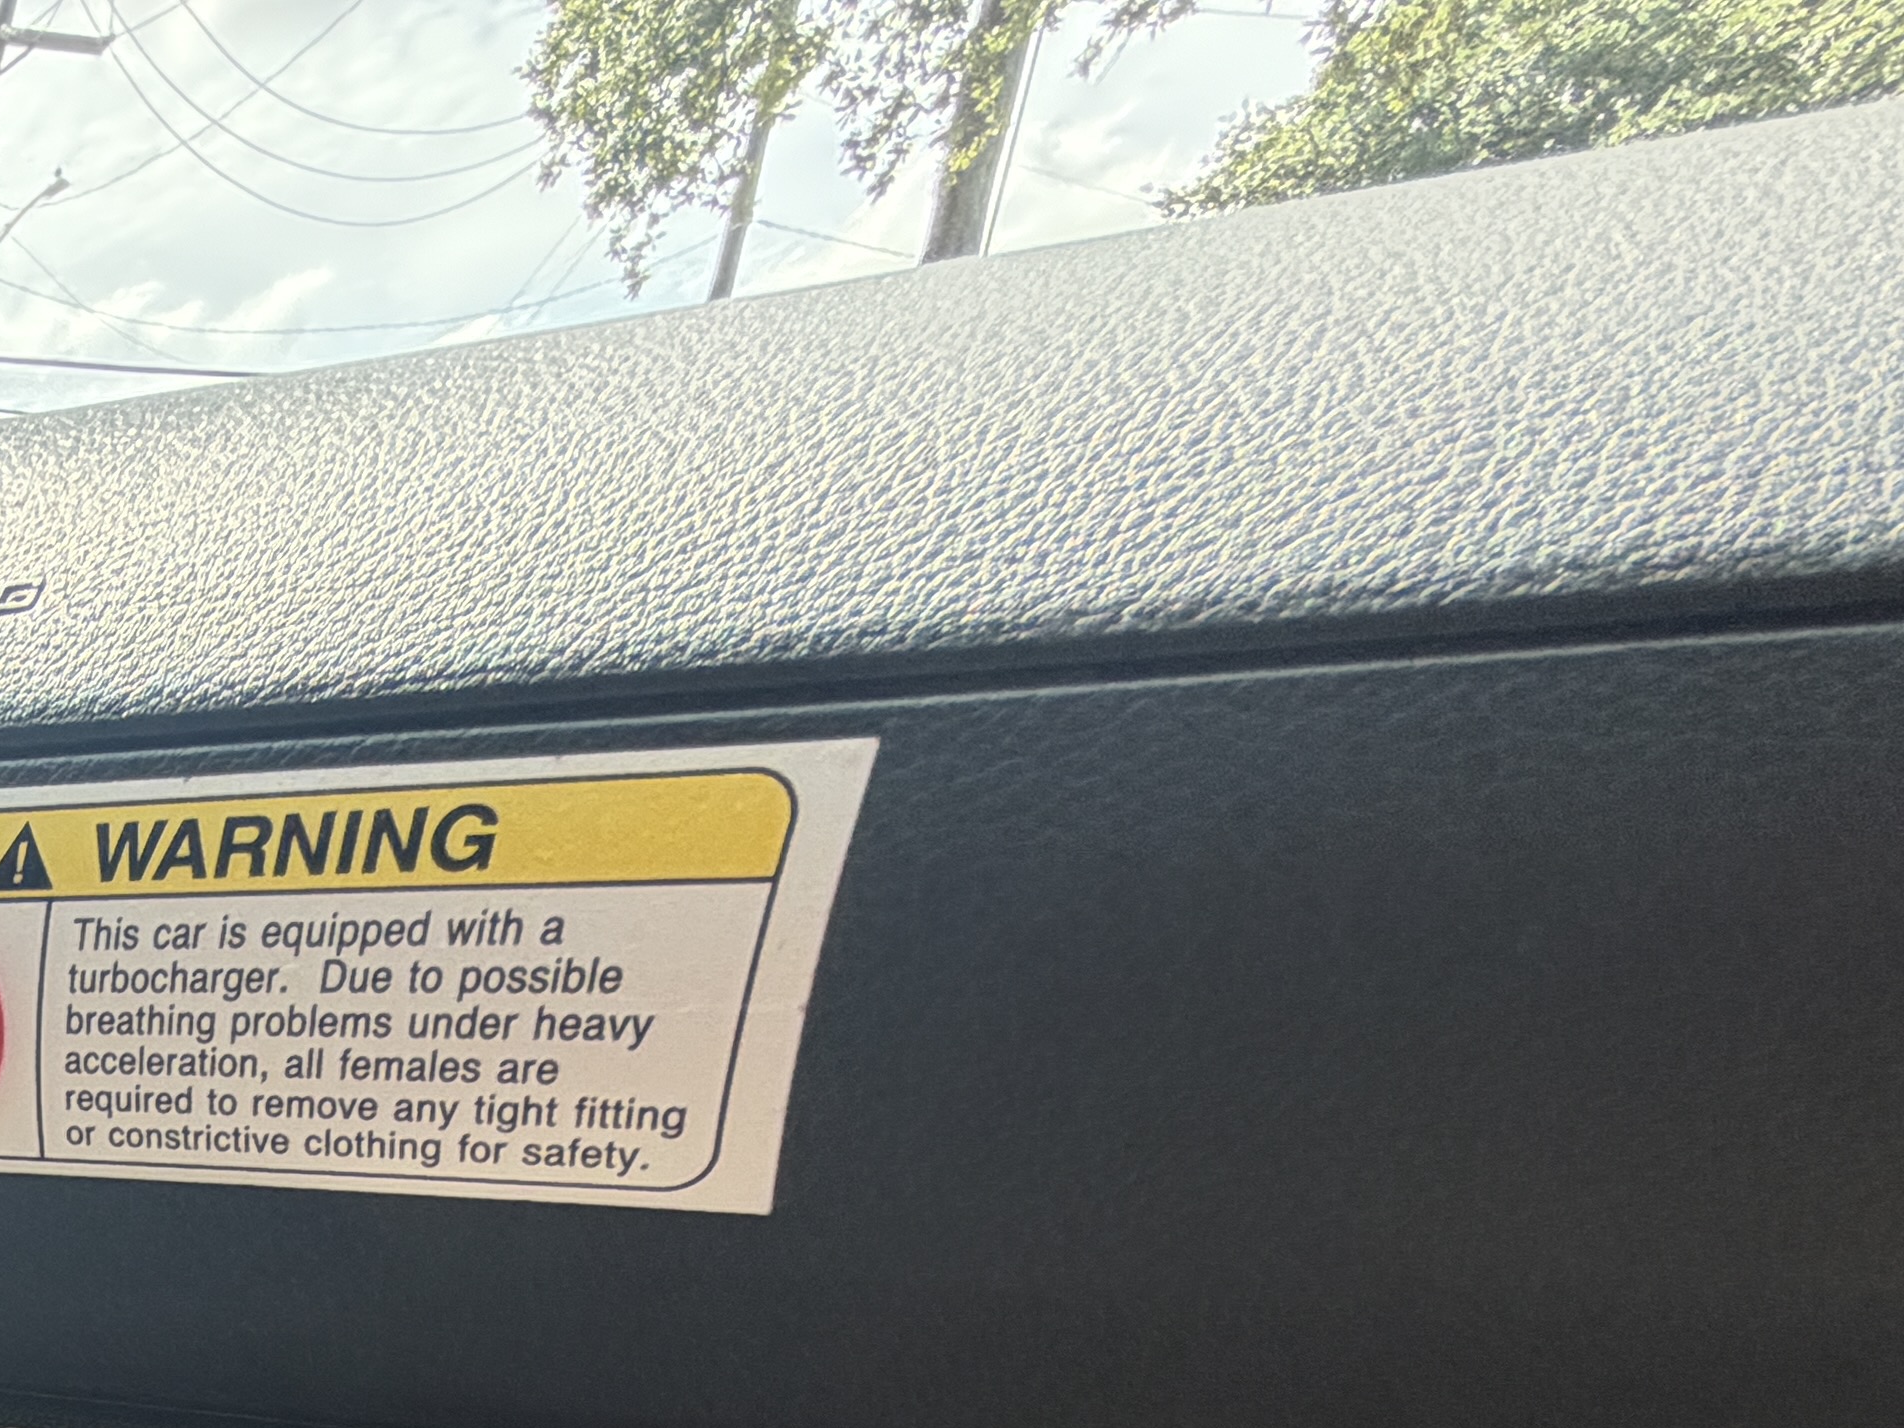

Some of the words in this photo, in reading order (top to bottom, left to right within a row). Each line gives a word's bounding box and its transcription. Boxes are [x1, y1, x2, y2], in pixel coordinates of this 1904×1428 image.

[96, 803, 499, 883] WARNING
[73, 916, 140, 951] This
[152, 920, 208, 950] car
[218, 914, 247, 950] is
[260, 909, 432, 957] equipped
[447, 908, 524, 946] with
[539, 915, 566, 945] a
[68, 960, 288, 1002] turbocharger.
[319, 958, 392, 994] Due
[409, 960, 443, 994] to
[456, 956, 624, 1003] possible
[65, 1003, 216, 1044] breathing
[230, 1003, 392, 1045] problems
[408, 1005, 520, 1040] under
[532, 1004, 655, 1051] heavy
[64, 1045, 269, 1084] acceleration,
[284, 1047, 324, 1080] all
[339, 1047, 482, 1084] females
[496, 1058, 559, 1086] are
[65, 1084, 193, 1119] required
[206, 1088, 238, 1116] to
[252, 1093, 378, 1121] remove
[393, 1098, 460, 1131] any
[474, 1094, 559, 1133] tight
[574, 1096, 687, 1139] fitting
[65, 1124, 96, 1146] or
[108, 1123, 289, 1154] constrictive
[304, 1128, 441, 1168] clothing
[458, 1132, 509, 1164] for
[521, 1137, 650, 1177] safety.
